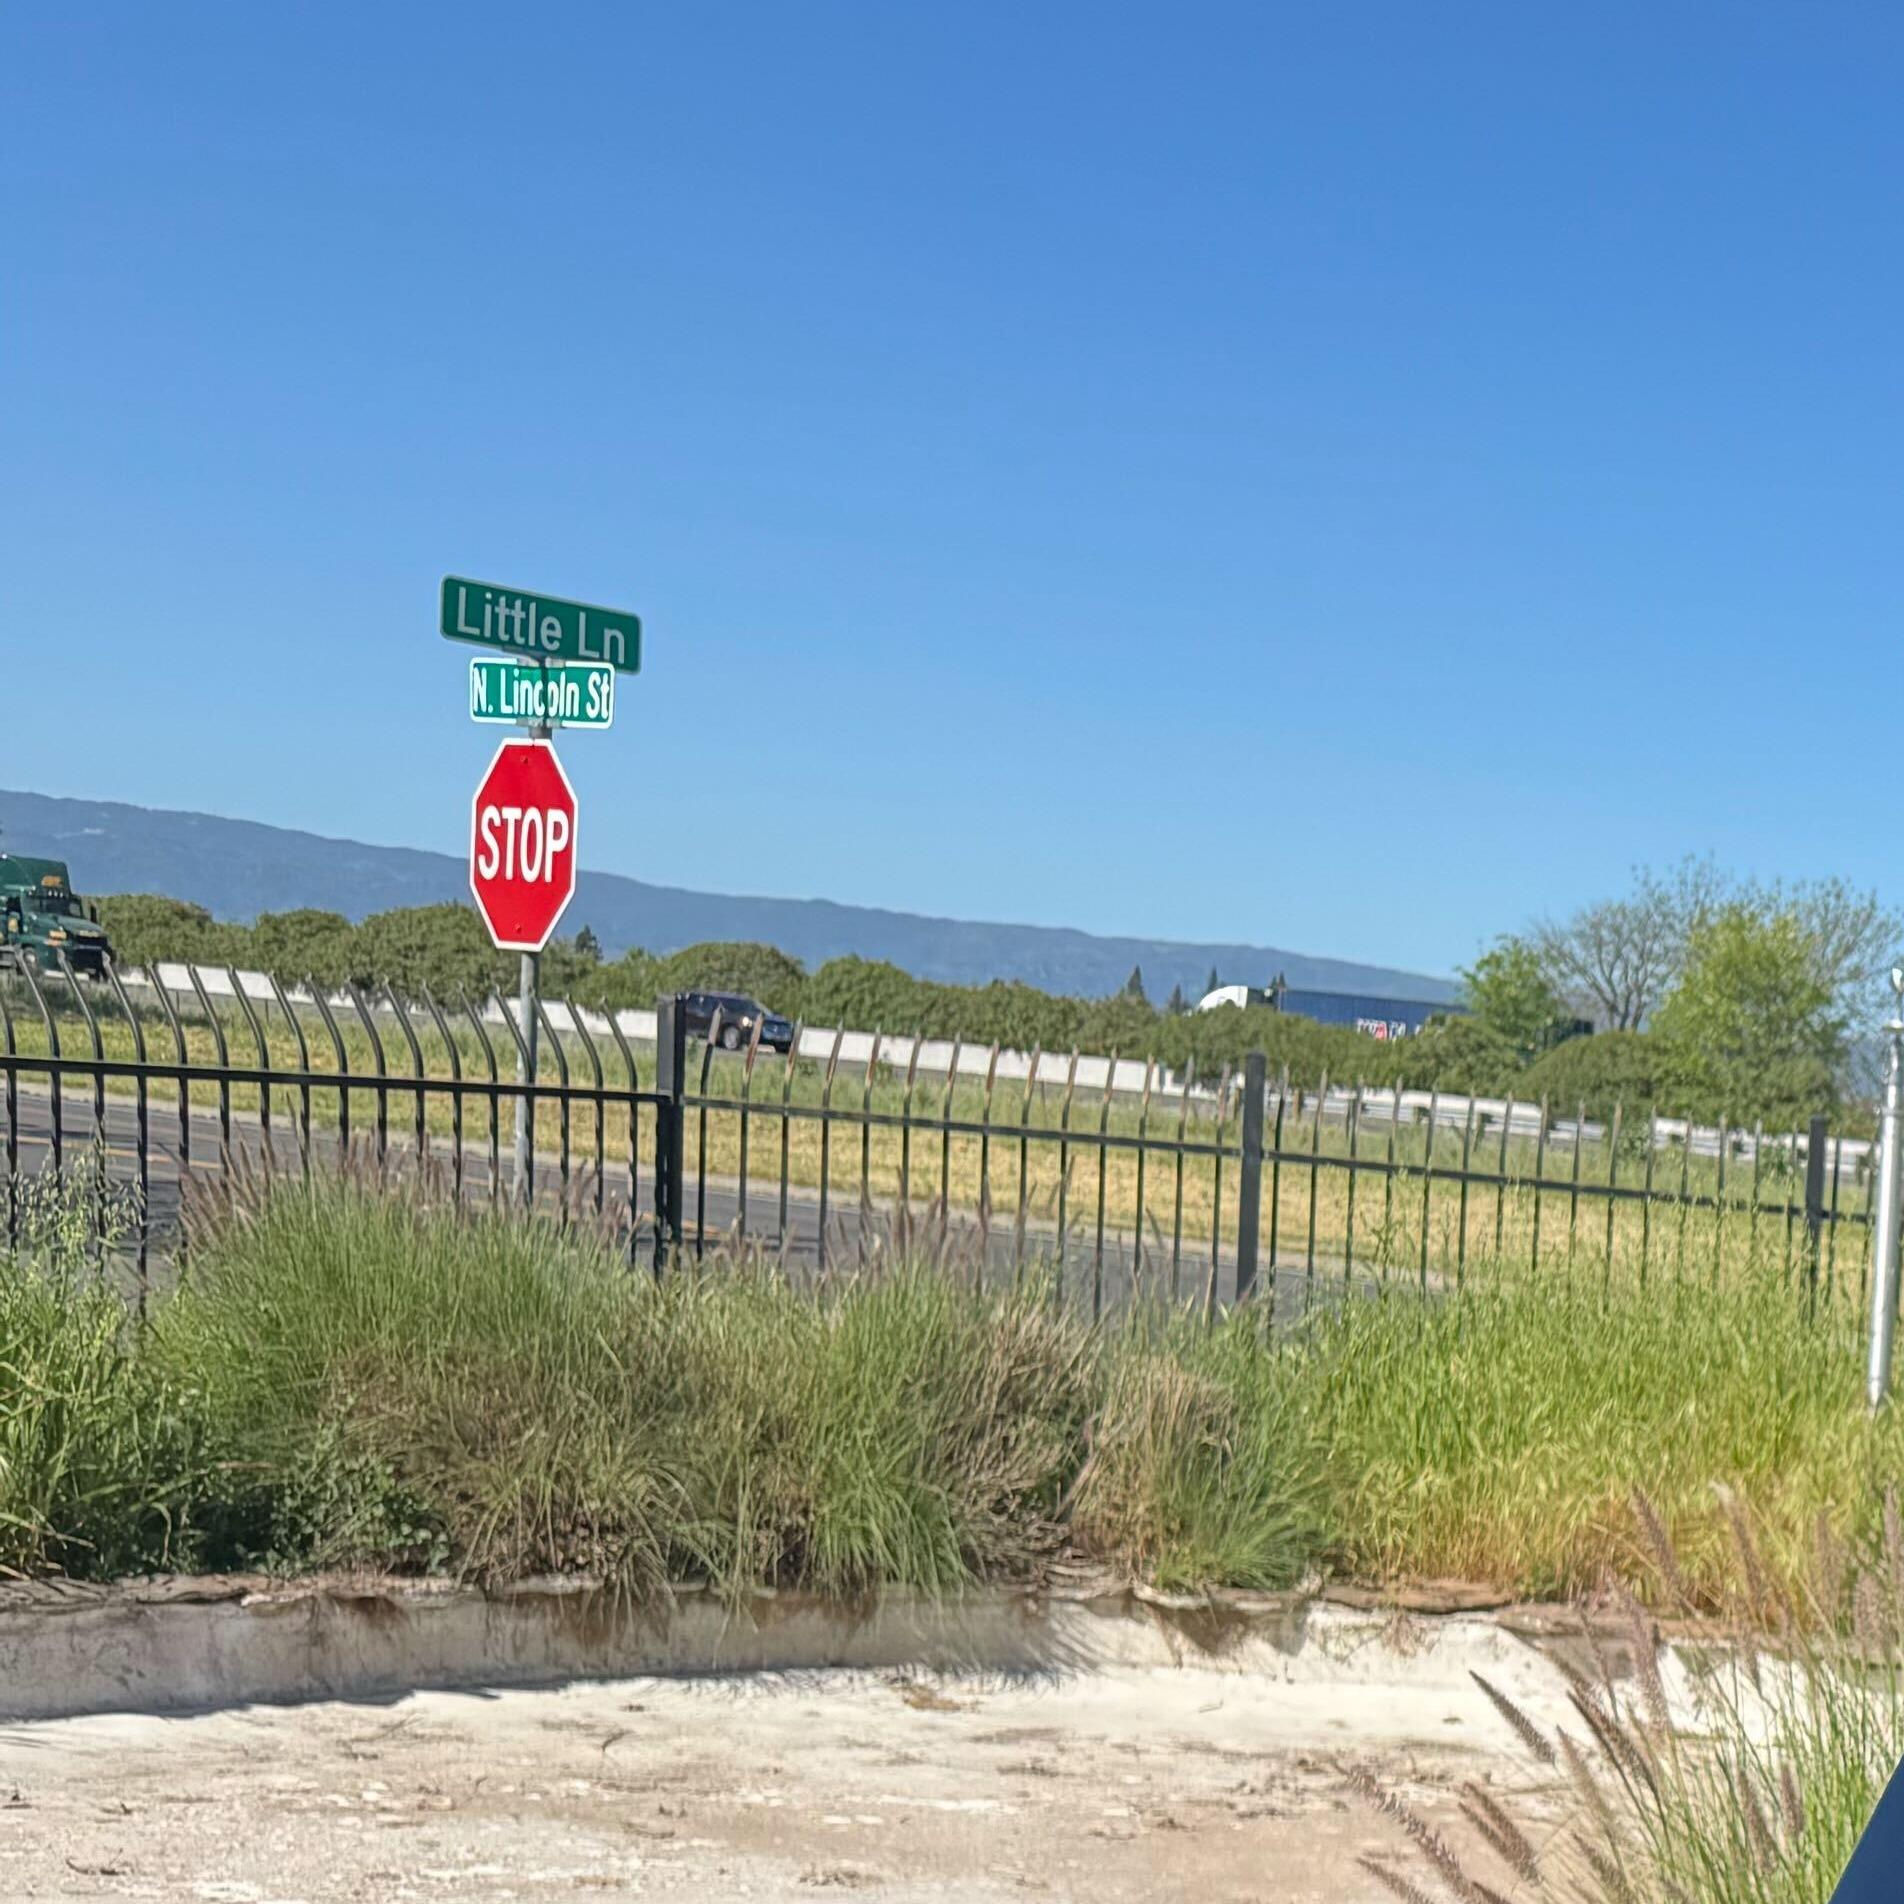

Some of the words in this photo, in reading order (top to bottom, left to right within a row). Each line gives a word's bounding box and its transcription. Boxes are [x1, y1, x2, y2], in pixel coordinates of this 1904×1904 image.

[456, 586, 563, 651] Little
[578, 611, 625, 665] Ln
[472, 666, 494, 714] N.
[500, 669, 581, 718] Lincoln
[586, 671, 610, 720] St
[477, 804, 569, 883] STOP
